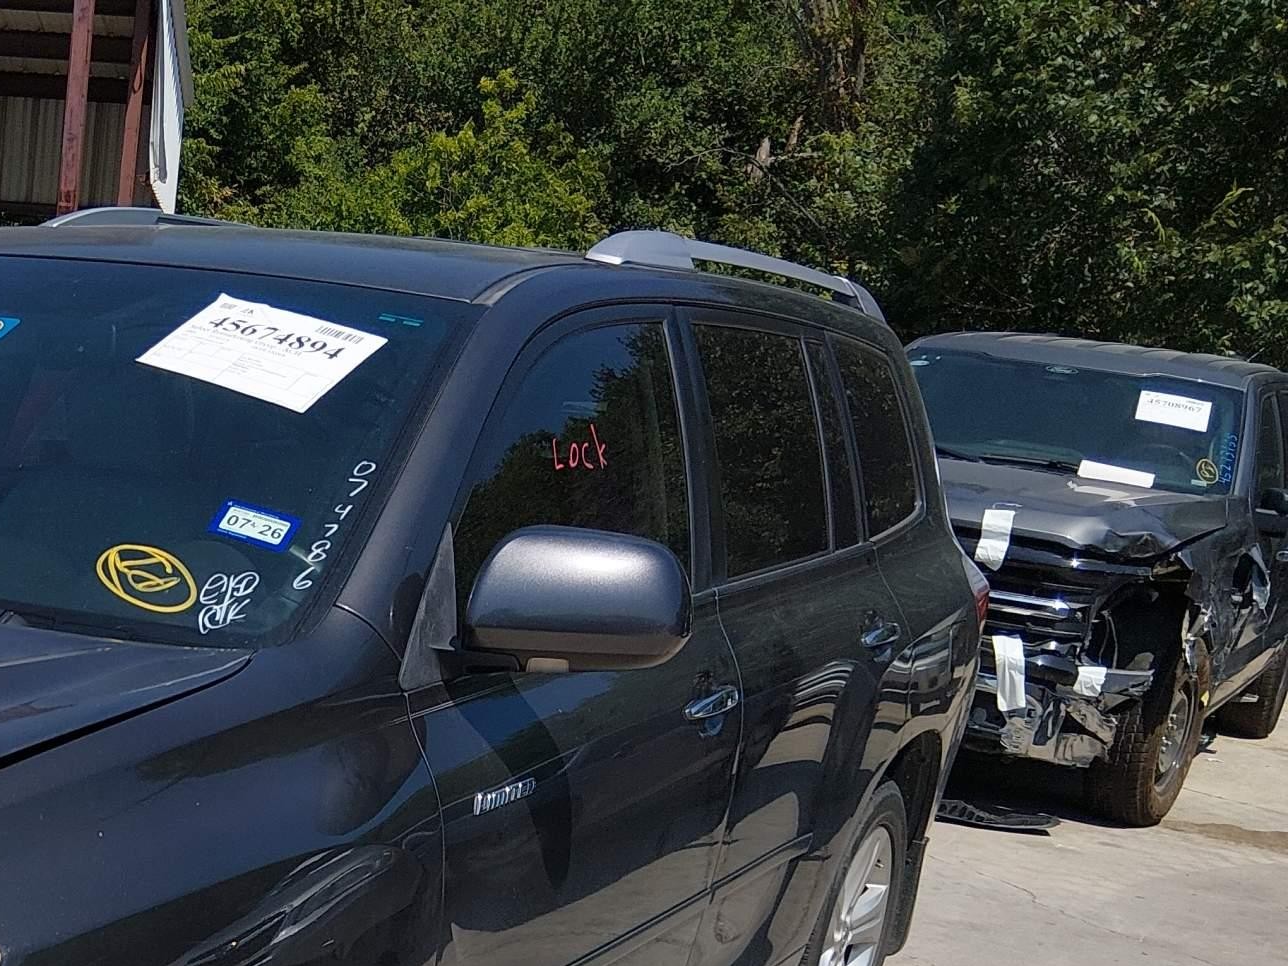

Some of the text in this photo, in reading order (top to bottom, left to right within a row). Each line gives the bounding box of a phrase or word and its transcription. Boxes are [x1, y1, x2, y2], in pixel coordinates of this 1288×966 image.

[209, 317, 345, 360] 45674894
[226, 514, 252, 529] 07
[258, 524, 284, 540] 26
